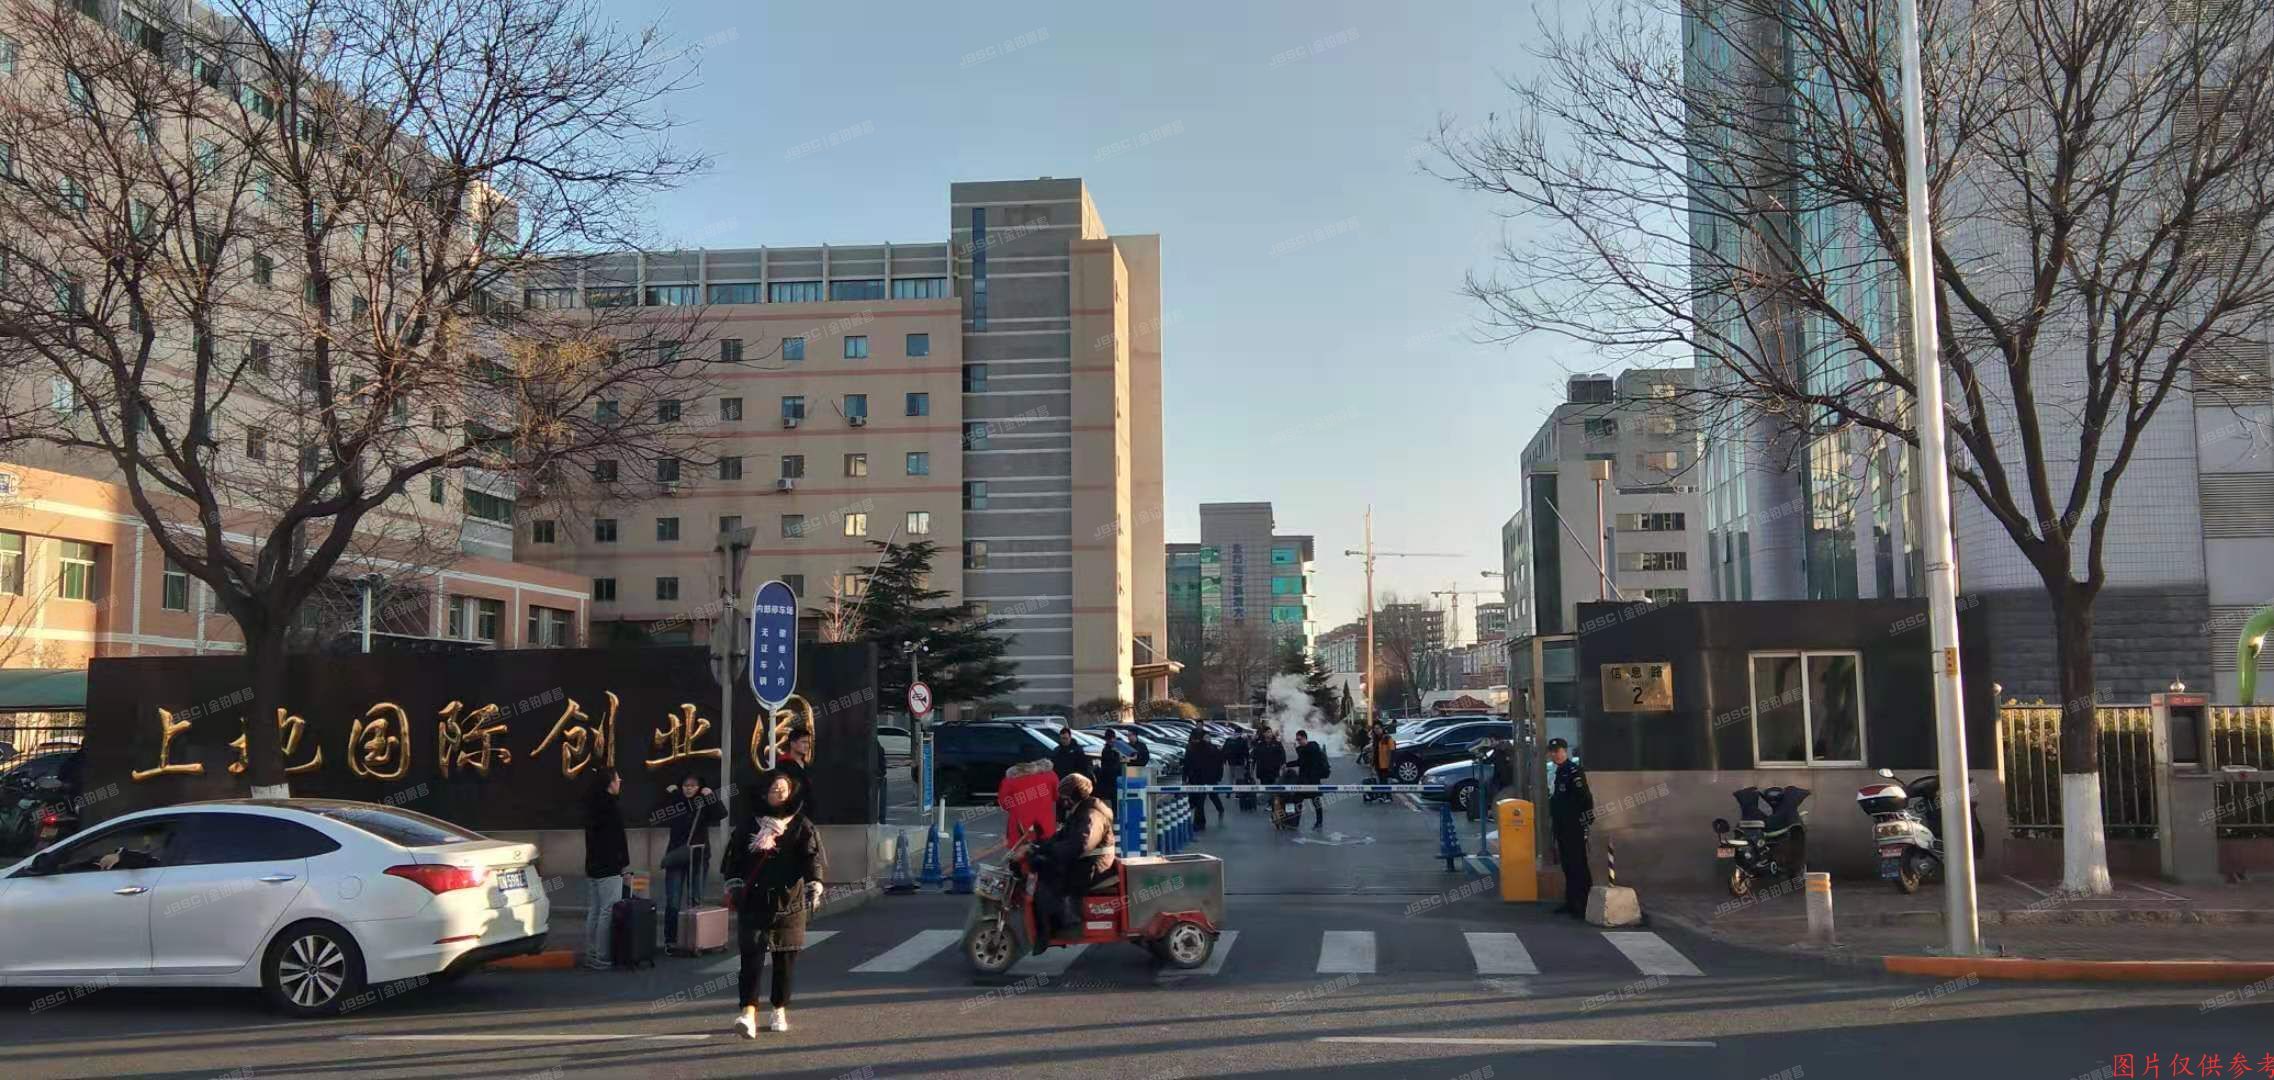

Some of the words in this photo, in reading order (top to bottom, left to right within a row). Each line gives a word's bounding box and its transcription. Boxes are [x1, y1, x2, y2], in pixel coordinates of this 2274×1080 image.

[1610, 665, 1663, 680] 信息路
[1632, 686, 1643, 704] 2
